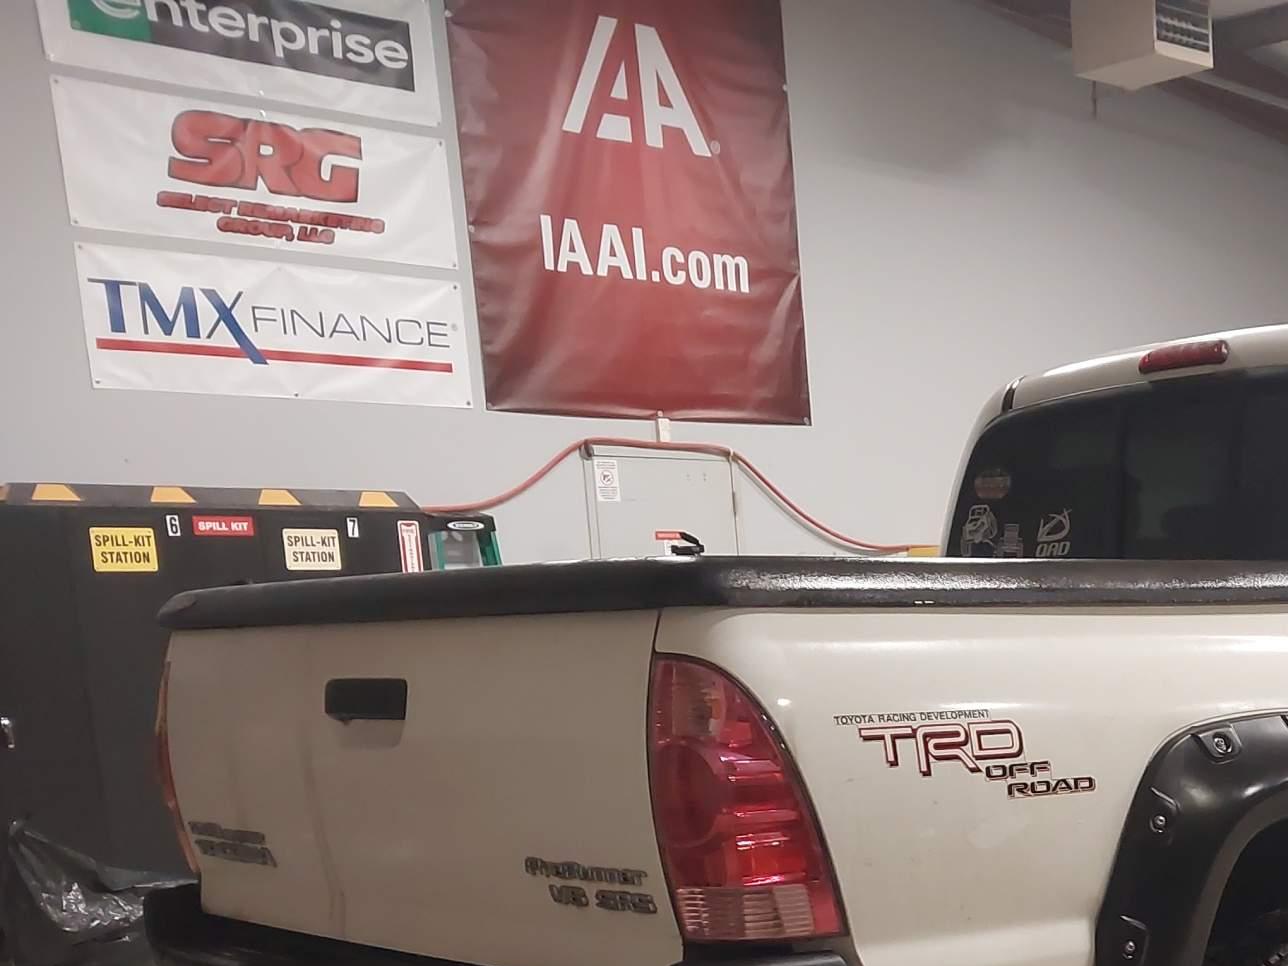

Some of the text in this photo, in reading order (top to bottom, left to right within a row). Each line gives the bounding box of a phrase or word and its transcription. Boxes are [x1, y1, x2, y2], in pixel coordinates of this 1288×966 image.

[168, 109, 363, 203] SRG
[540, 214, 750, 293] IAAI.com
[168, 516, 179, 535] 6
[198, 521, 249, 532] SPILL KIT
[349, 519, 357, 536] 7
[95, 535, 152, 547] SPILL-KIT
[287, 535, 336, 548] SPILL-KIT
[101, 551, 150, 564] STATION
[292, 551, 335, 563] STATION
[833, 709, 990, 726] TOYOTA RACING DEVELOPMENT
[859, 720, 1025, 777] TRD
[985, 760, 1051, 781] OFF
[1007, 776, 1097, 799] ROAD
